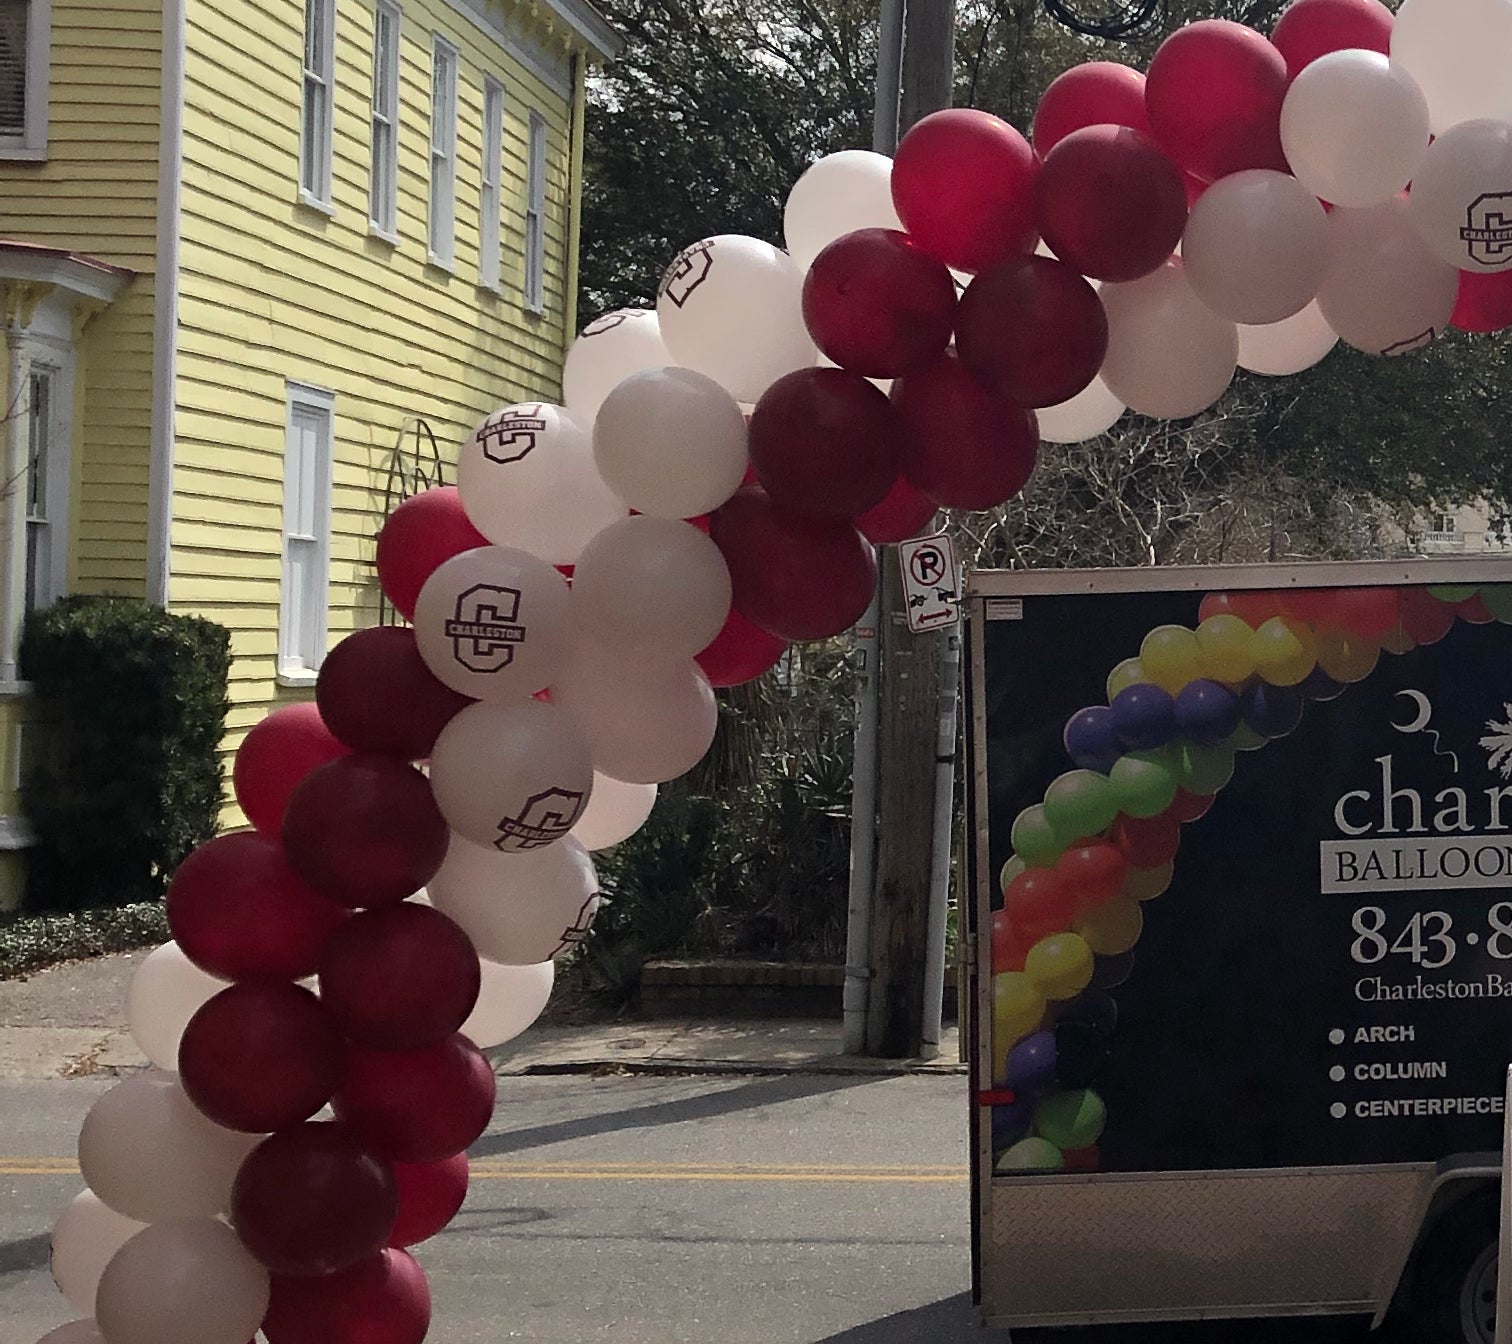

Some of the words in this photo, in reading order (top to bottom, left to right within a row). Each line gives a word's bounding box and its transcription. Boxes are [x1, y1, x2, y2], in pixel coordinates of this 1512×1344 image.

[448, 623, 523, 640] CHARLESTON
[1353, 1025, 1415, 1043] ARCH
[1353, 1061, 1447, 1080] COLUMN
[1354, 1096, 1504, 1118] CENTERPIECE
